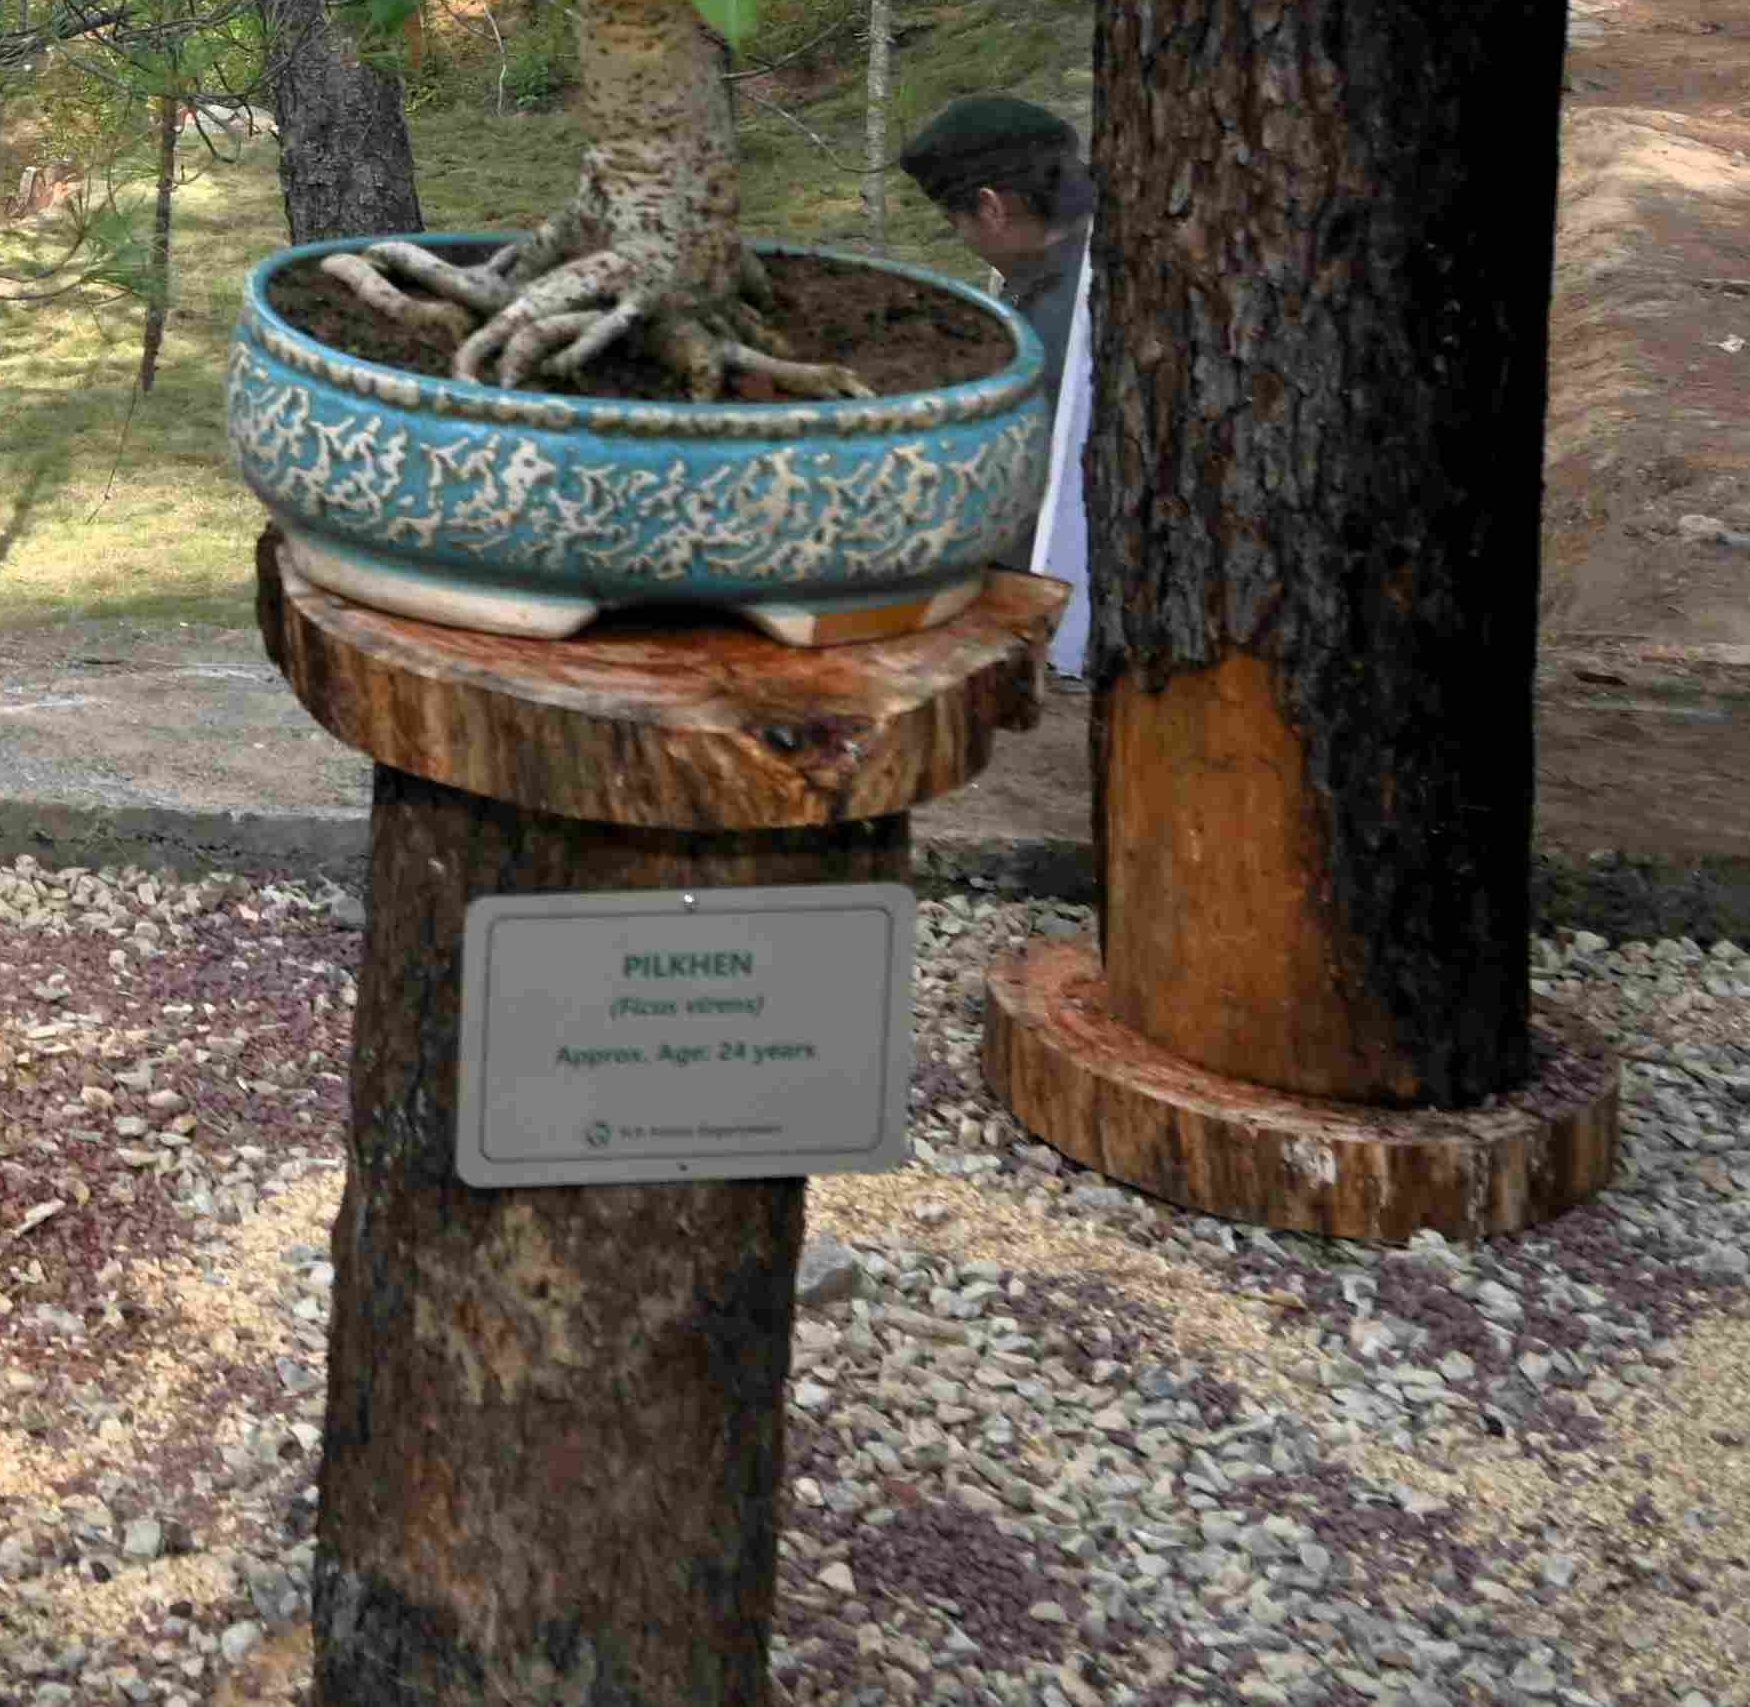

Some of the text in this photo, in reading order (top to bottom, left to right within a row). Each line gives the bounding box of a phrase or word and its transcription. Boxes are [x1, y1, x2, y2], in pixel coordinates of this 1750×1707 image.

[623, 951, 754, 979] PILKHEN
[718, 1042, 748, 1061] 24
[752, 1043, 817, 1066] years
